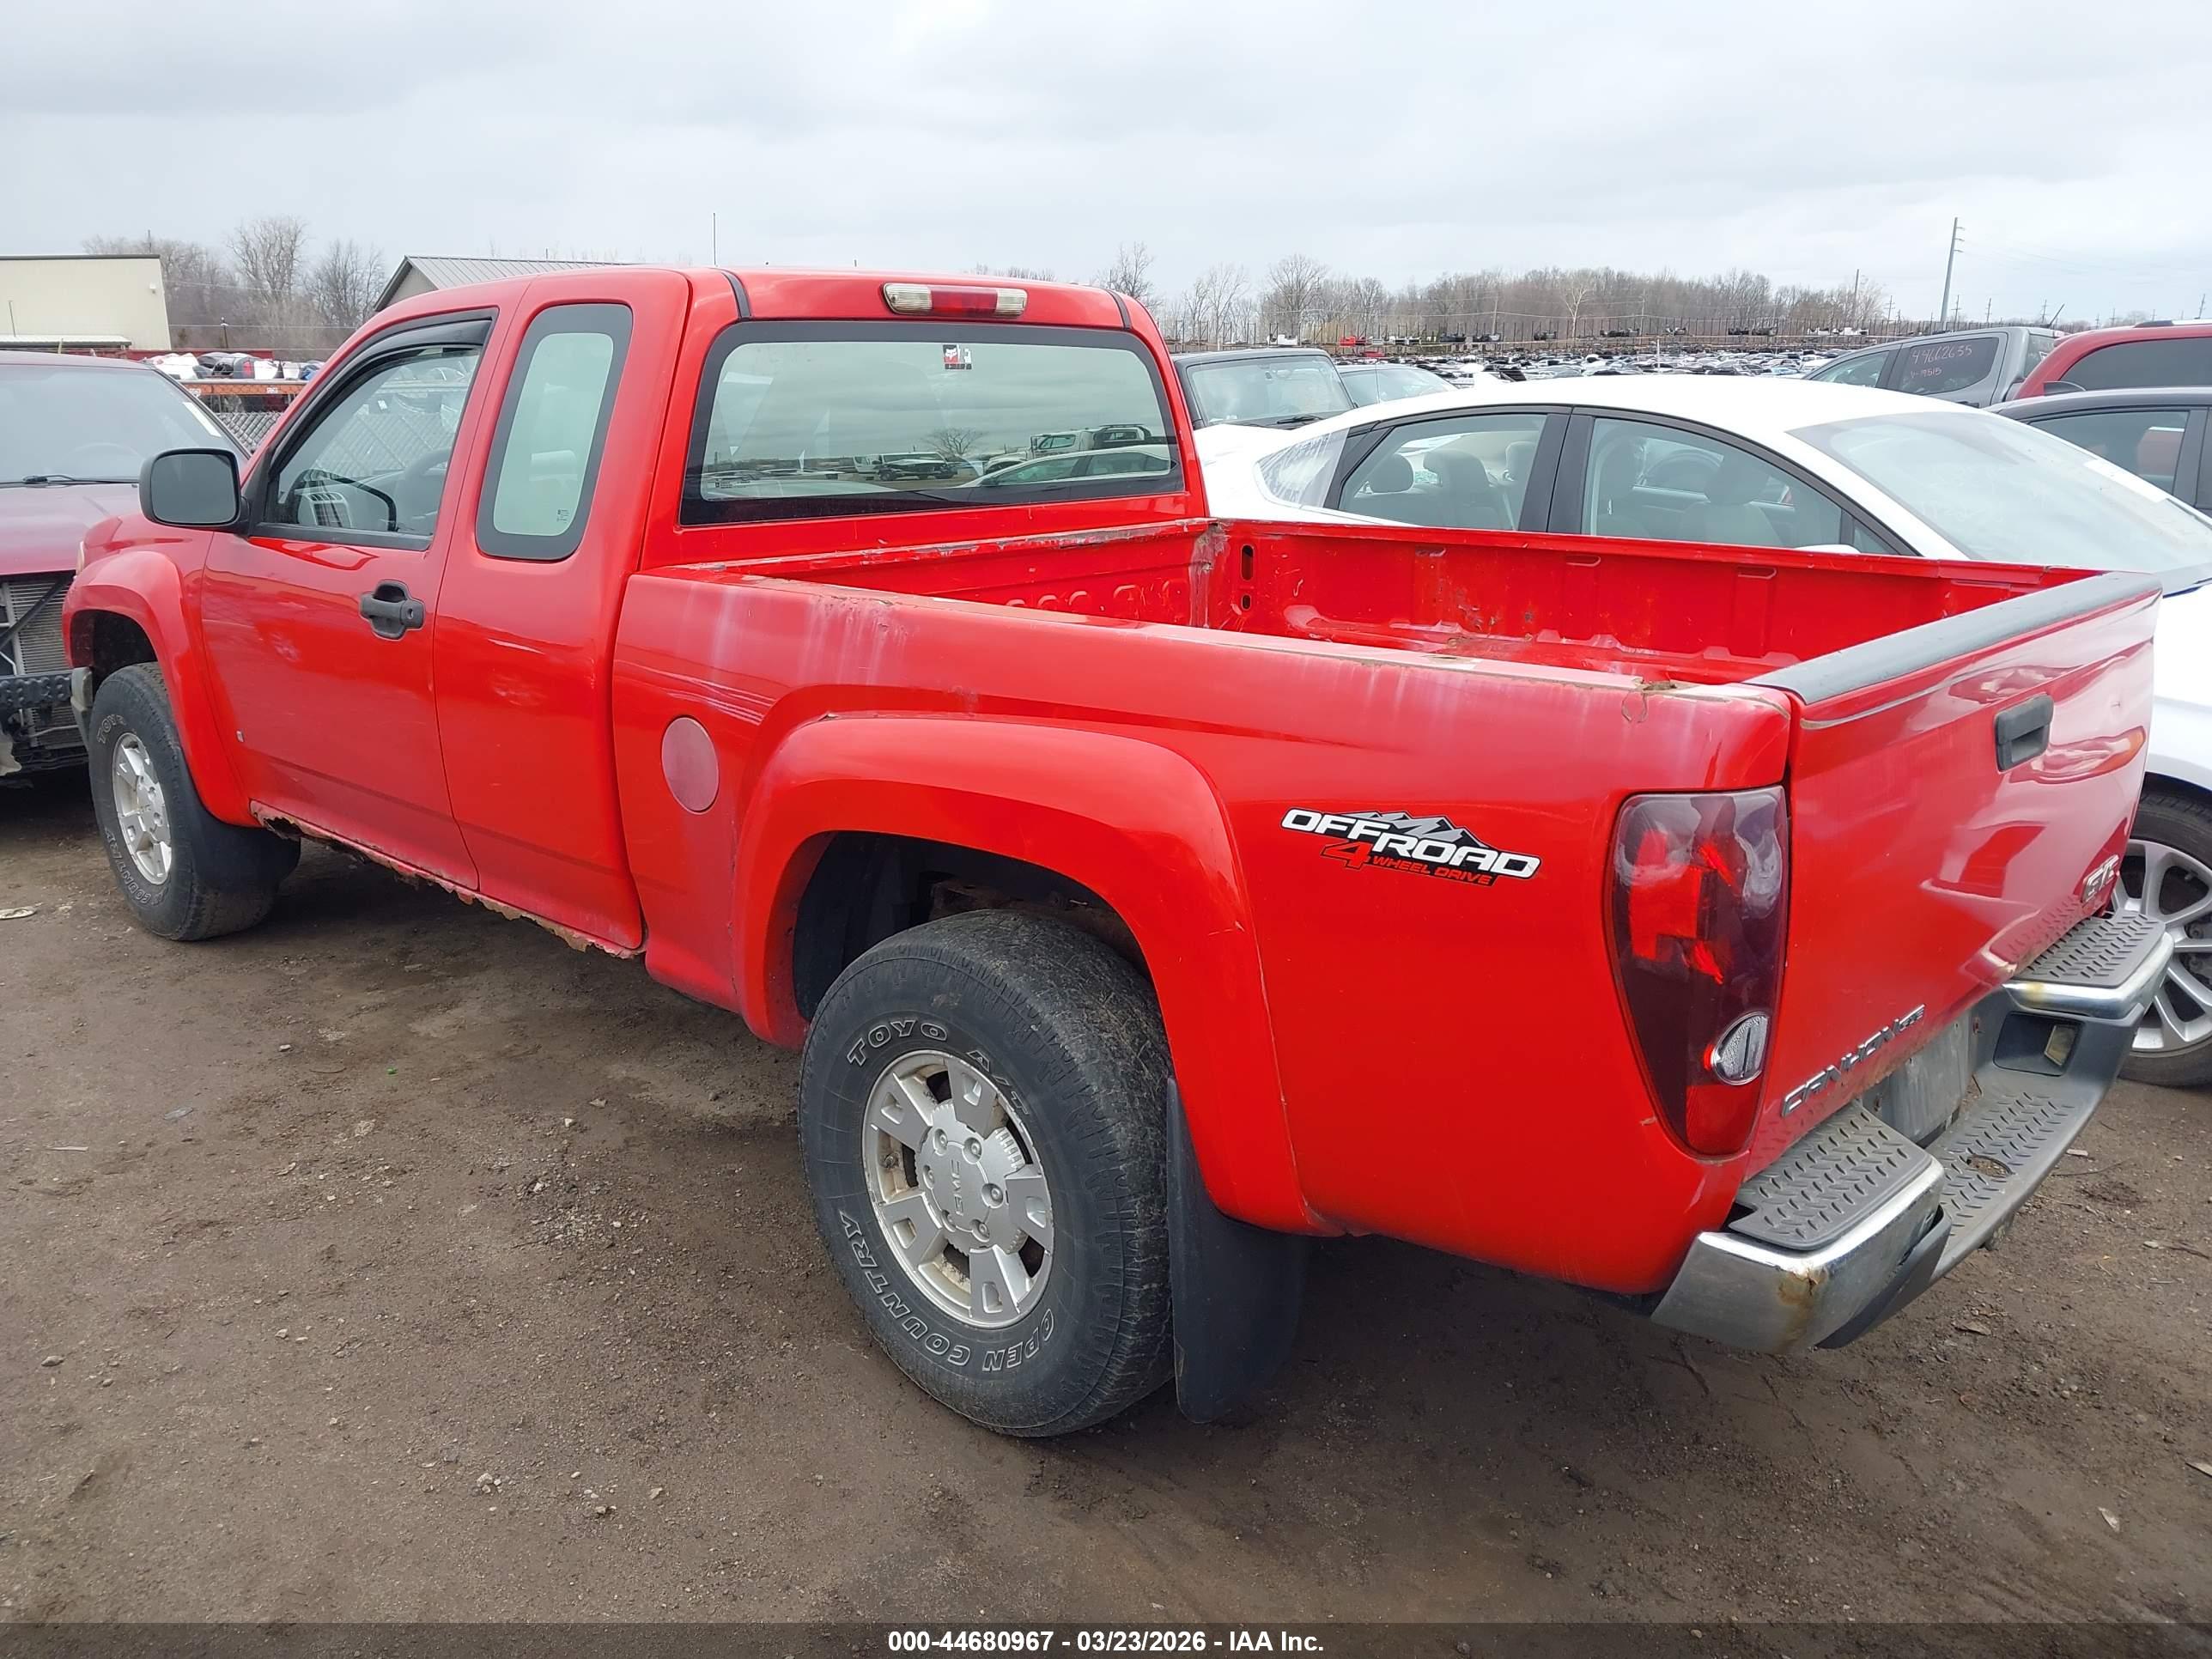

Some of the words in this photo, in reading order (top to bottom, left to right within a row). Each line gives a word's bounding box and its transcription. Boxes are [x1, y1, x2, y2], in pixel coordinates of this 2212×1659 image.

[1321, 842, 1372, 869] 4
[1373, 854, 1431, 875] WHEEL
[1433, 866, 1493, 885] DRIVE
[847, 1019, 948, 1066] TOYO
[951, 1159, 963, 1216] GMC
[839, 1209, 971, 1366] COUNTRY
[981, 1308, 1054, 1372] OPEN
